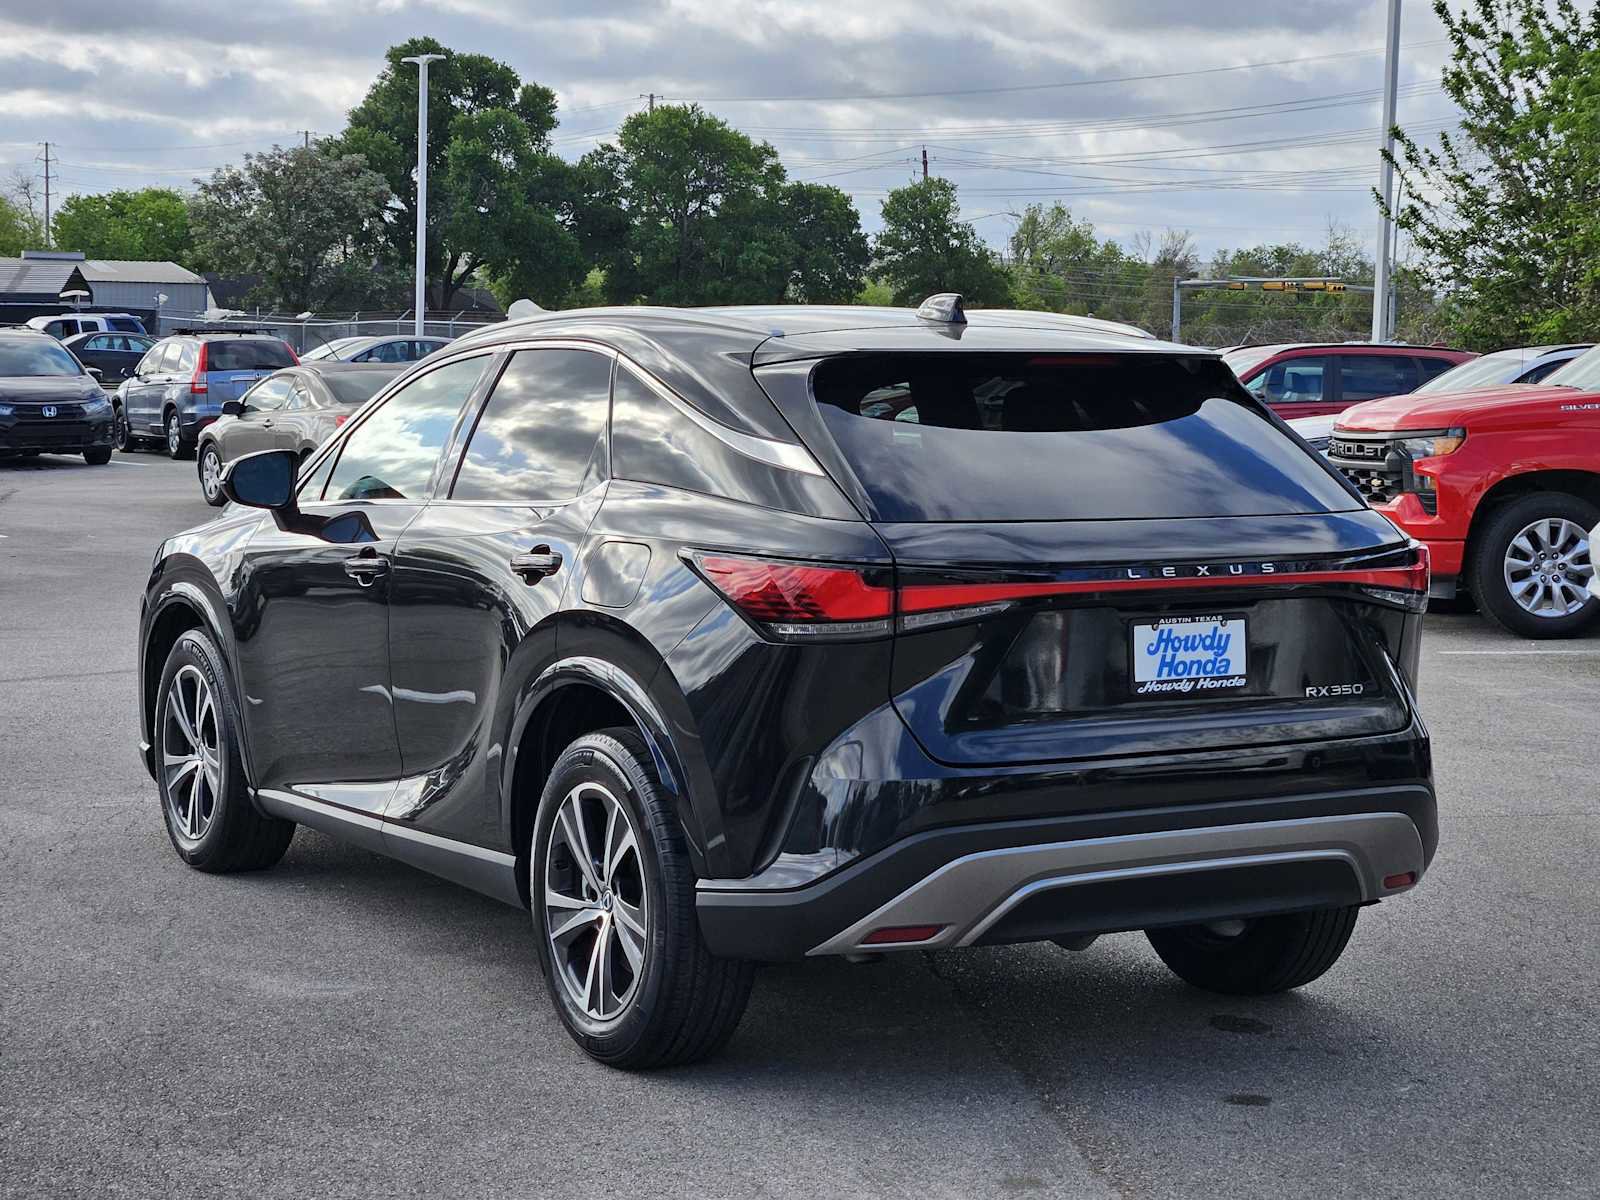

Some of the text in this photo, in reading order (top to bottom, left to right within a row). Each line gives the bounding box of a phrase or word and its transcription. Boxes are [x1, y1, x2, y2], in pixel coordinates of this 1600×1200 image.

[1127, 562, 1275, 579] LEXUS
[1159, 615, 1223, 625] AUSTIN TEXAS
[1146, 626, 1231, 657] Howdy
[1156, 653, 1231, 678] Honda
[1137, 675, 1247, 694] Howdy Honda
